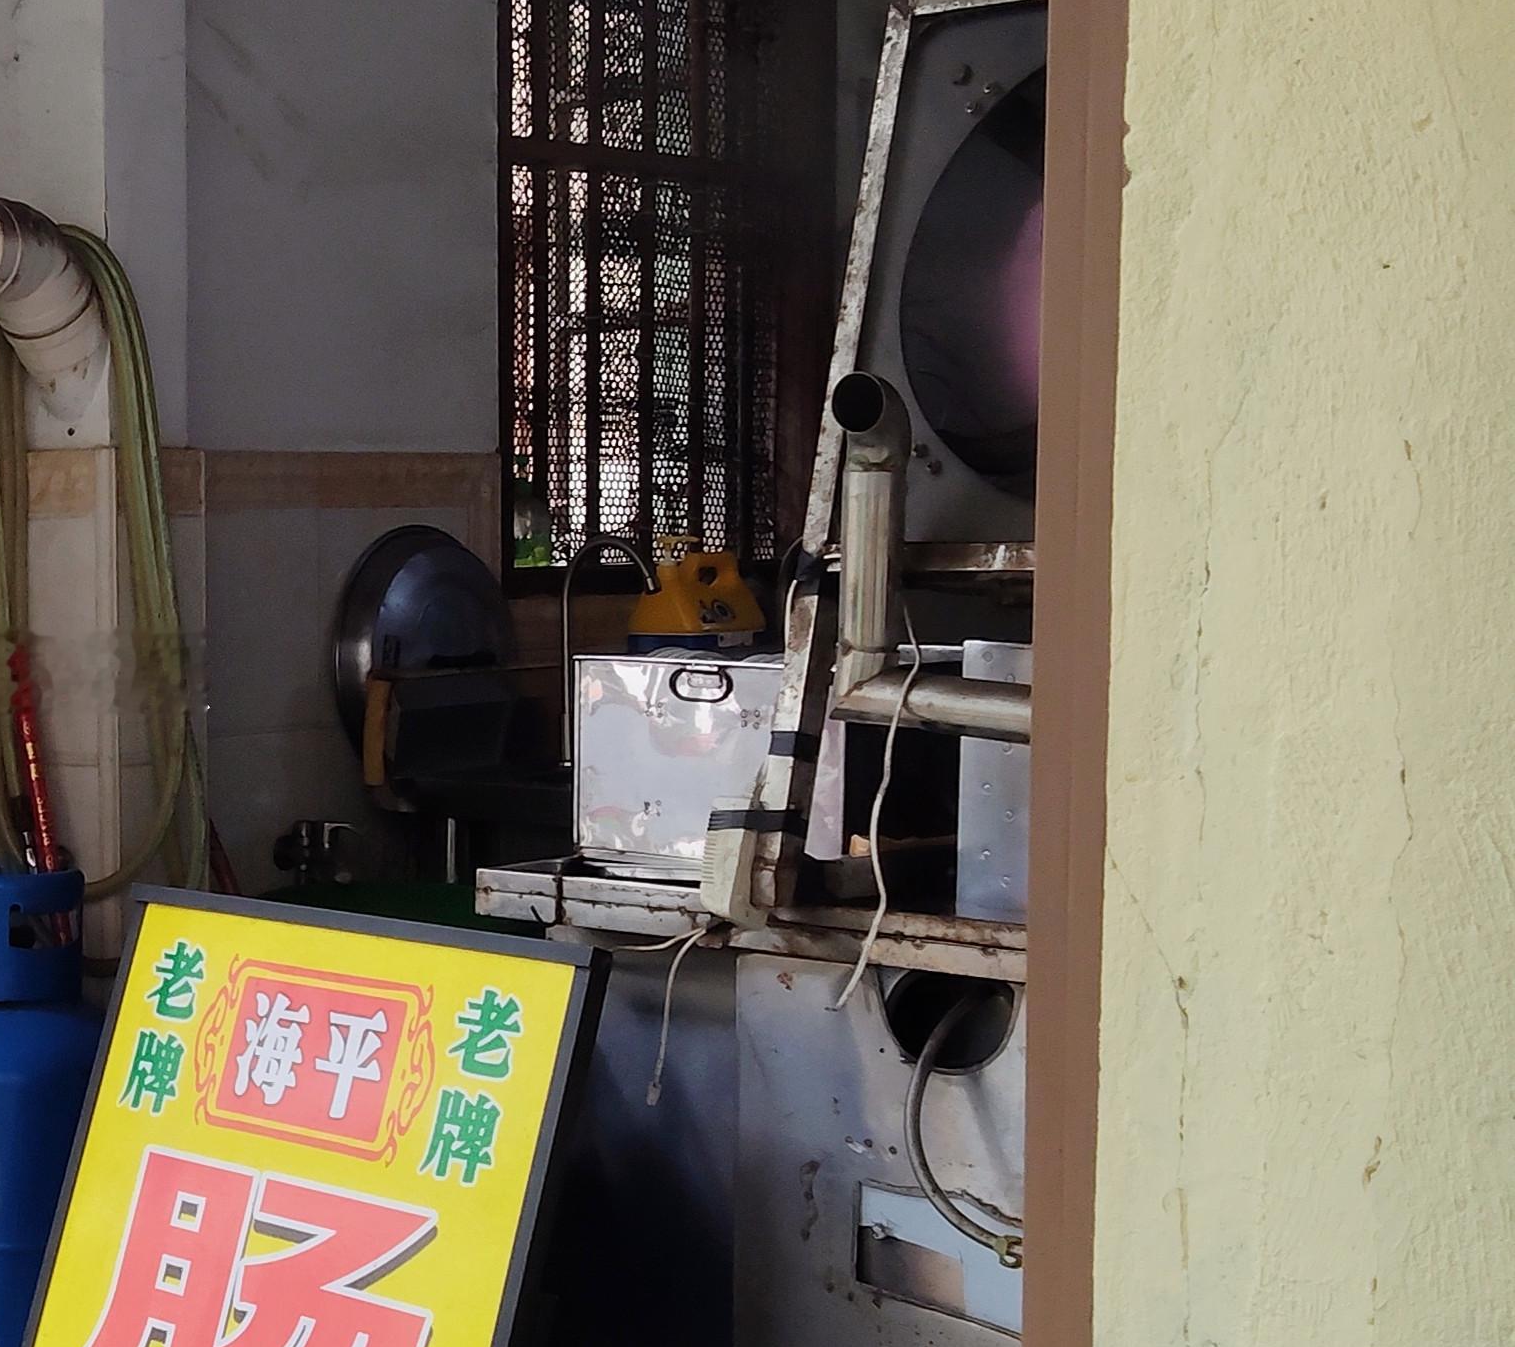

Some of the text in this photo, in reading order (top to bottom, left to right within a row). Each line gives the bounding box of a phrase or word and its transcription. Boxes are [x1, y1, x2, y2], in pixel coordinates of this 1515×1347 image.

[118, 939, 209, 1117] 老牌
[234, 991, 389, 1120] 海平
[417, 987, 525, 1187] 老牌
